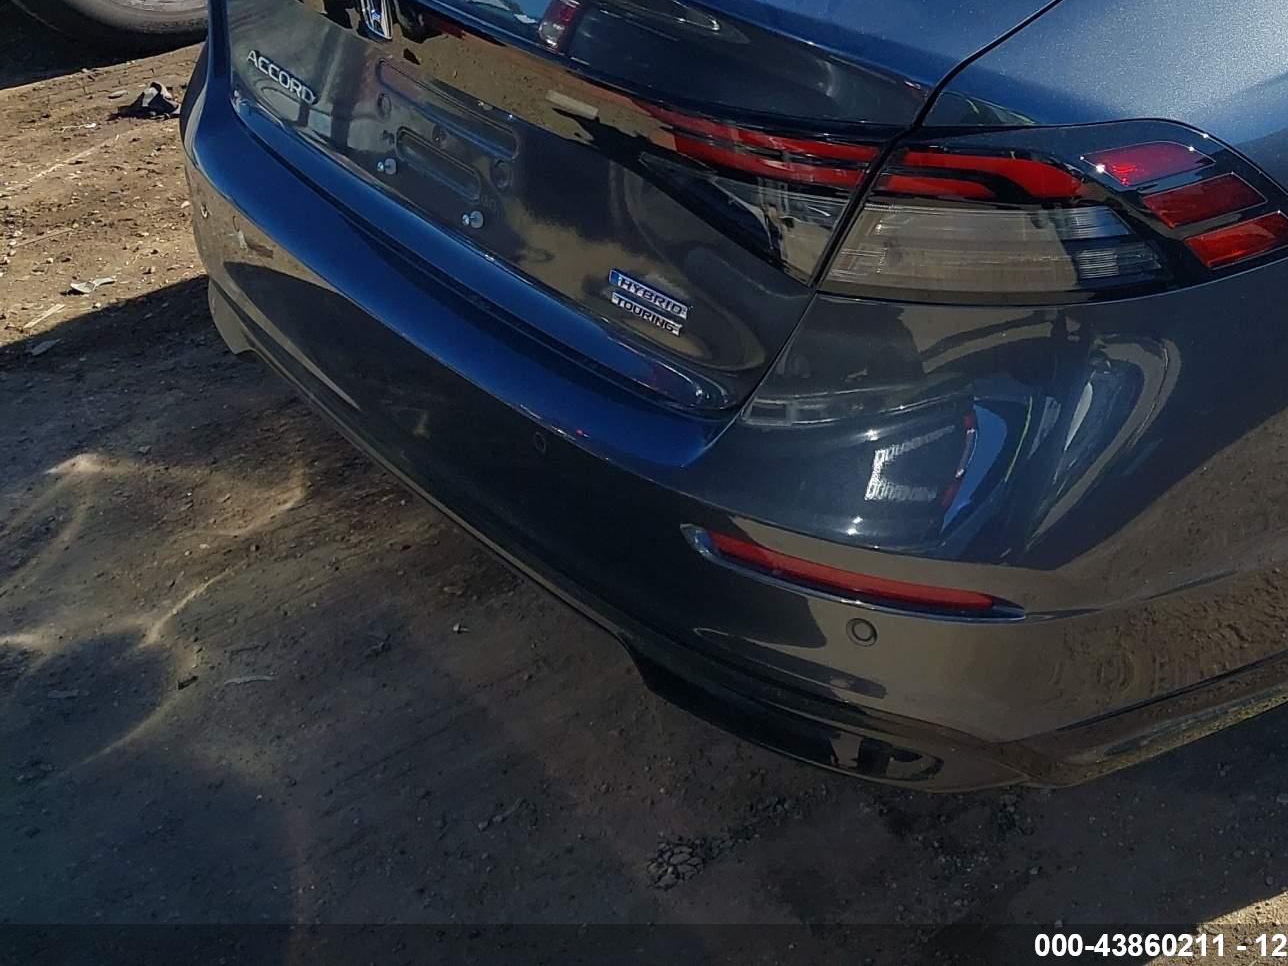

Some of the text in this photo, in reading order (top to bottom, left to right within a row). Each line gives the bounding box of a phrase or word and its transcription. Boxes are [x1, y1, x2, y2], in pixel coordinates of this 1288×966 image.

[246, 49, 318, 106] ACCORD
[613, 295, 678, 333] TOURING
[619, 277, 683, 316] HYBRID
